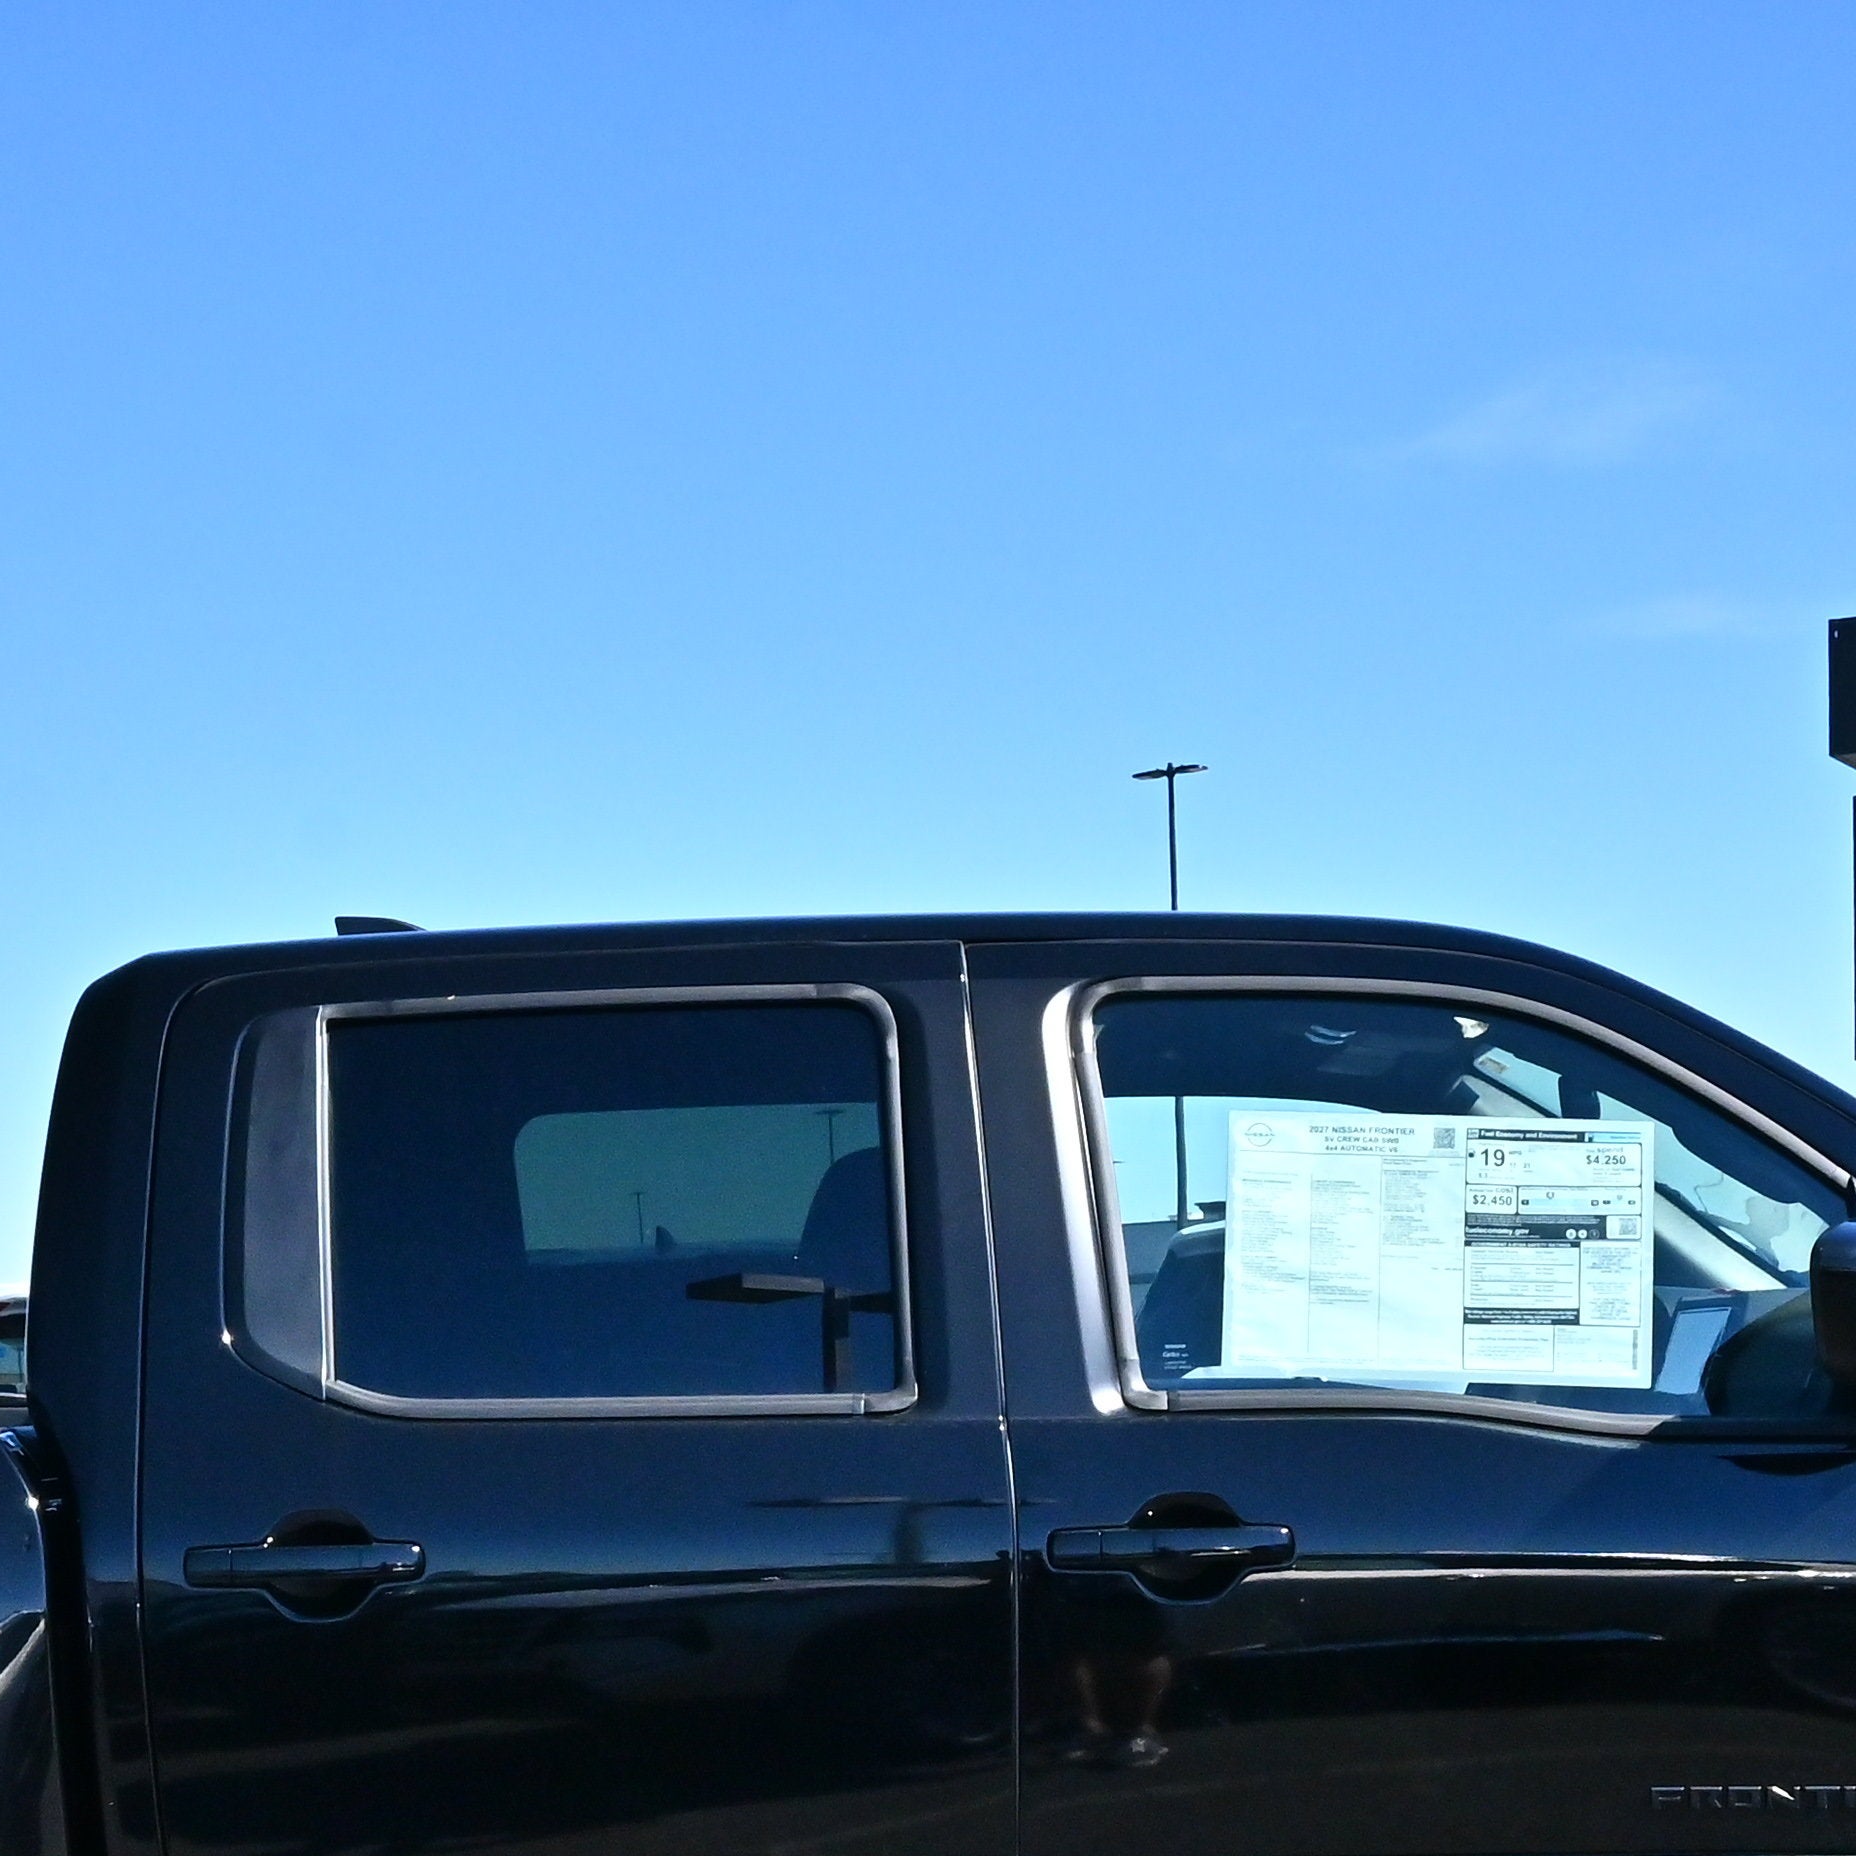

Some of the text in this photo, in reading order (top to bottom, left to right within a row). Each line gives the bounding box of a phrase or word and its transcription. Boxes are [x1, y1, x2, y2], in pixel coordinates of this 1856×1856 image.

[1332, 1126, 1366, 1134] NISSAN
[1369, 1127, 1415, 1135] FRONTIER
[1480, 1148, 1505, 1167] 19
